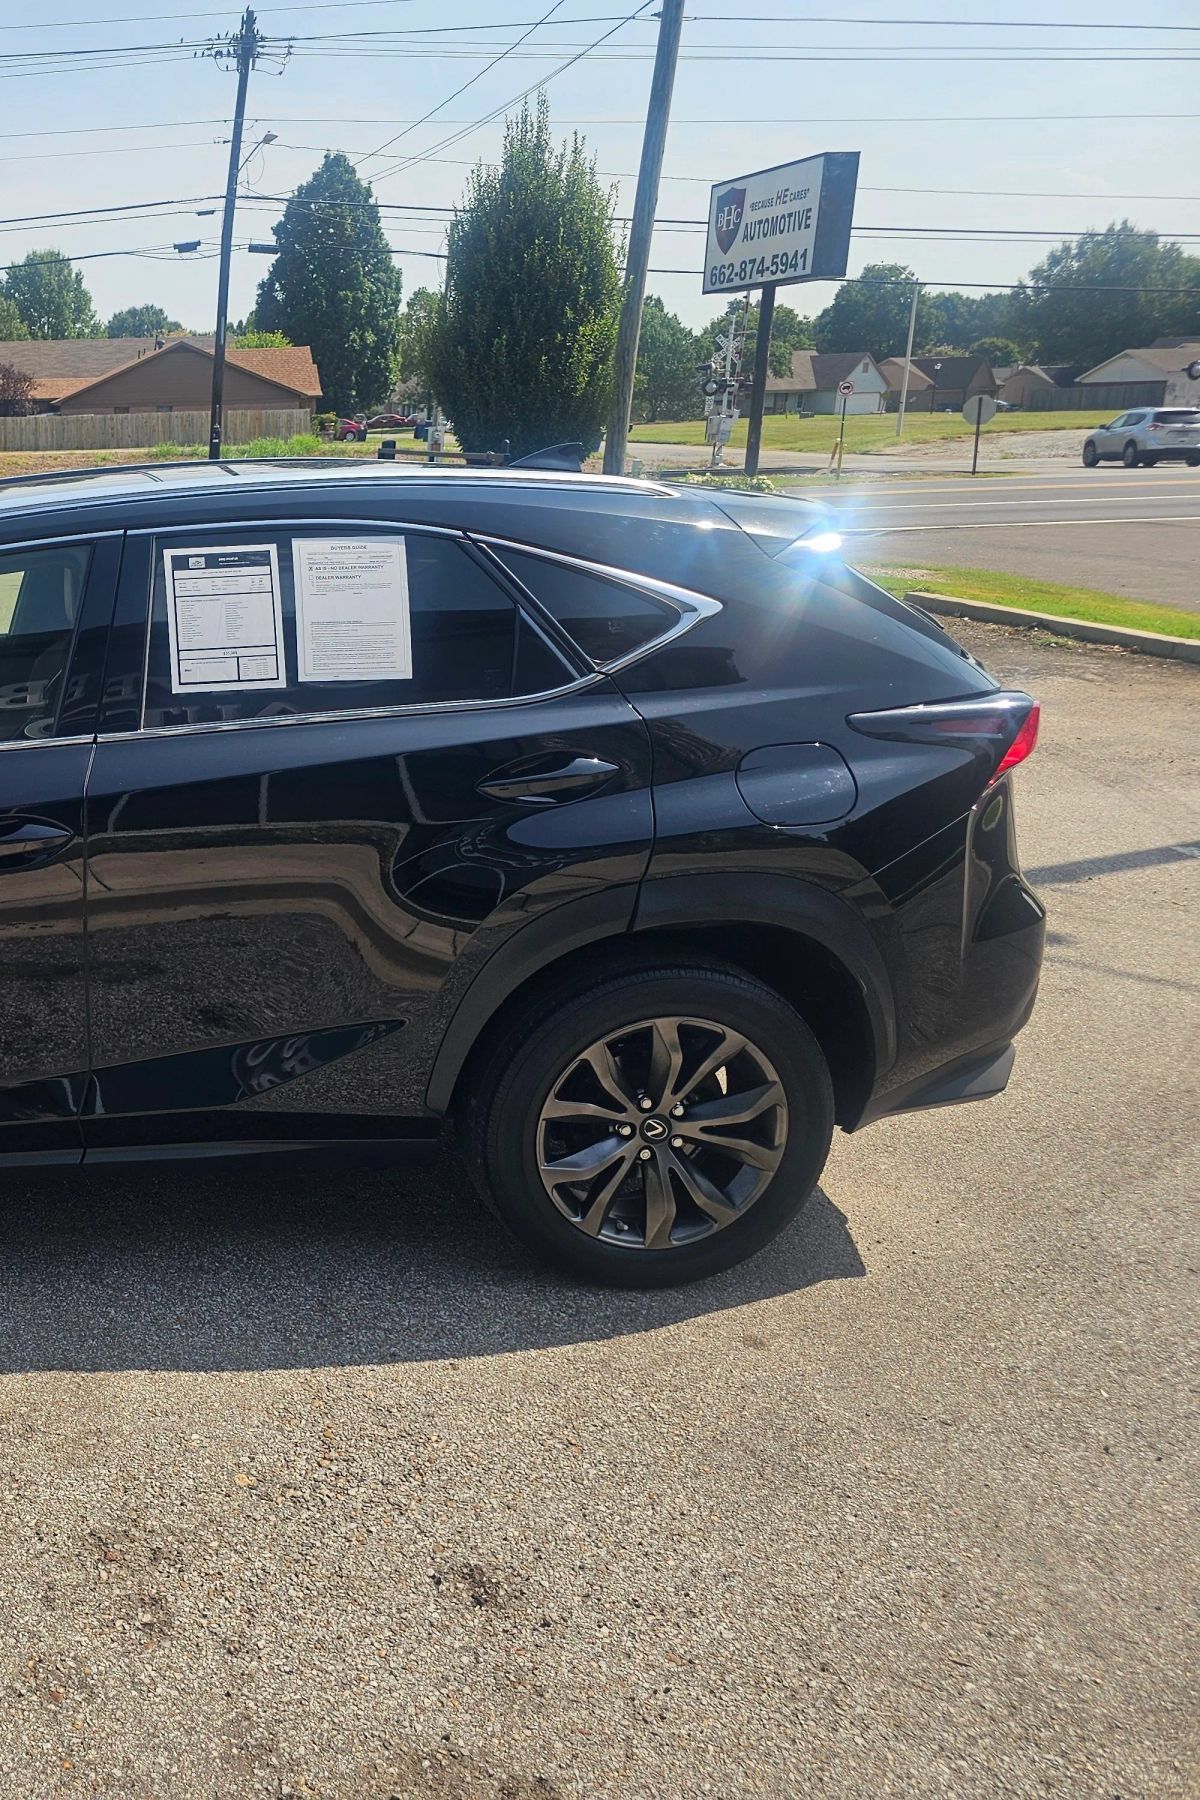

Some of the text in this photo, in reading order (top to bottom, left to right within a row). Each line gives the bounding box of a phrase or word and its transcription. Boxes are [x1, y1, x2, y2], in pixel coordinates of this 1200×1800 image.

[775, 188, 789, 205] HE
[718, 204, 741, 231] BHC
[742, 208, 812, 243] AUTOMOTIVE
[709, 249, 808, 286] 662-874-5941
